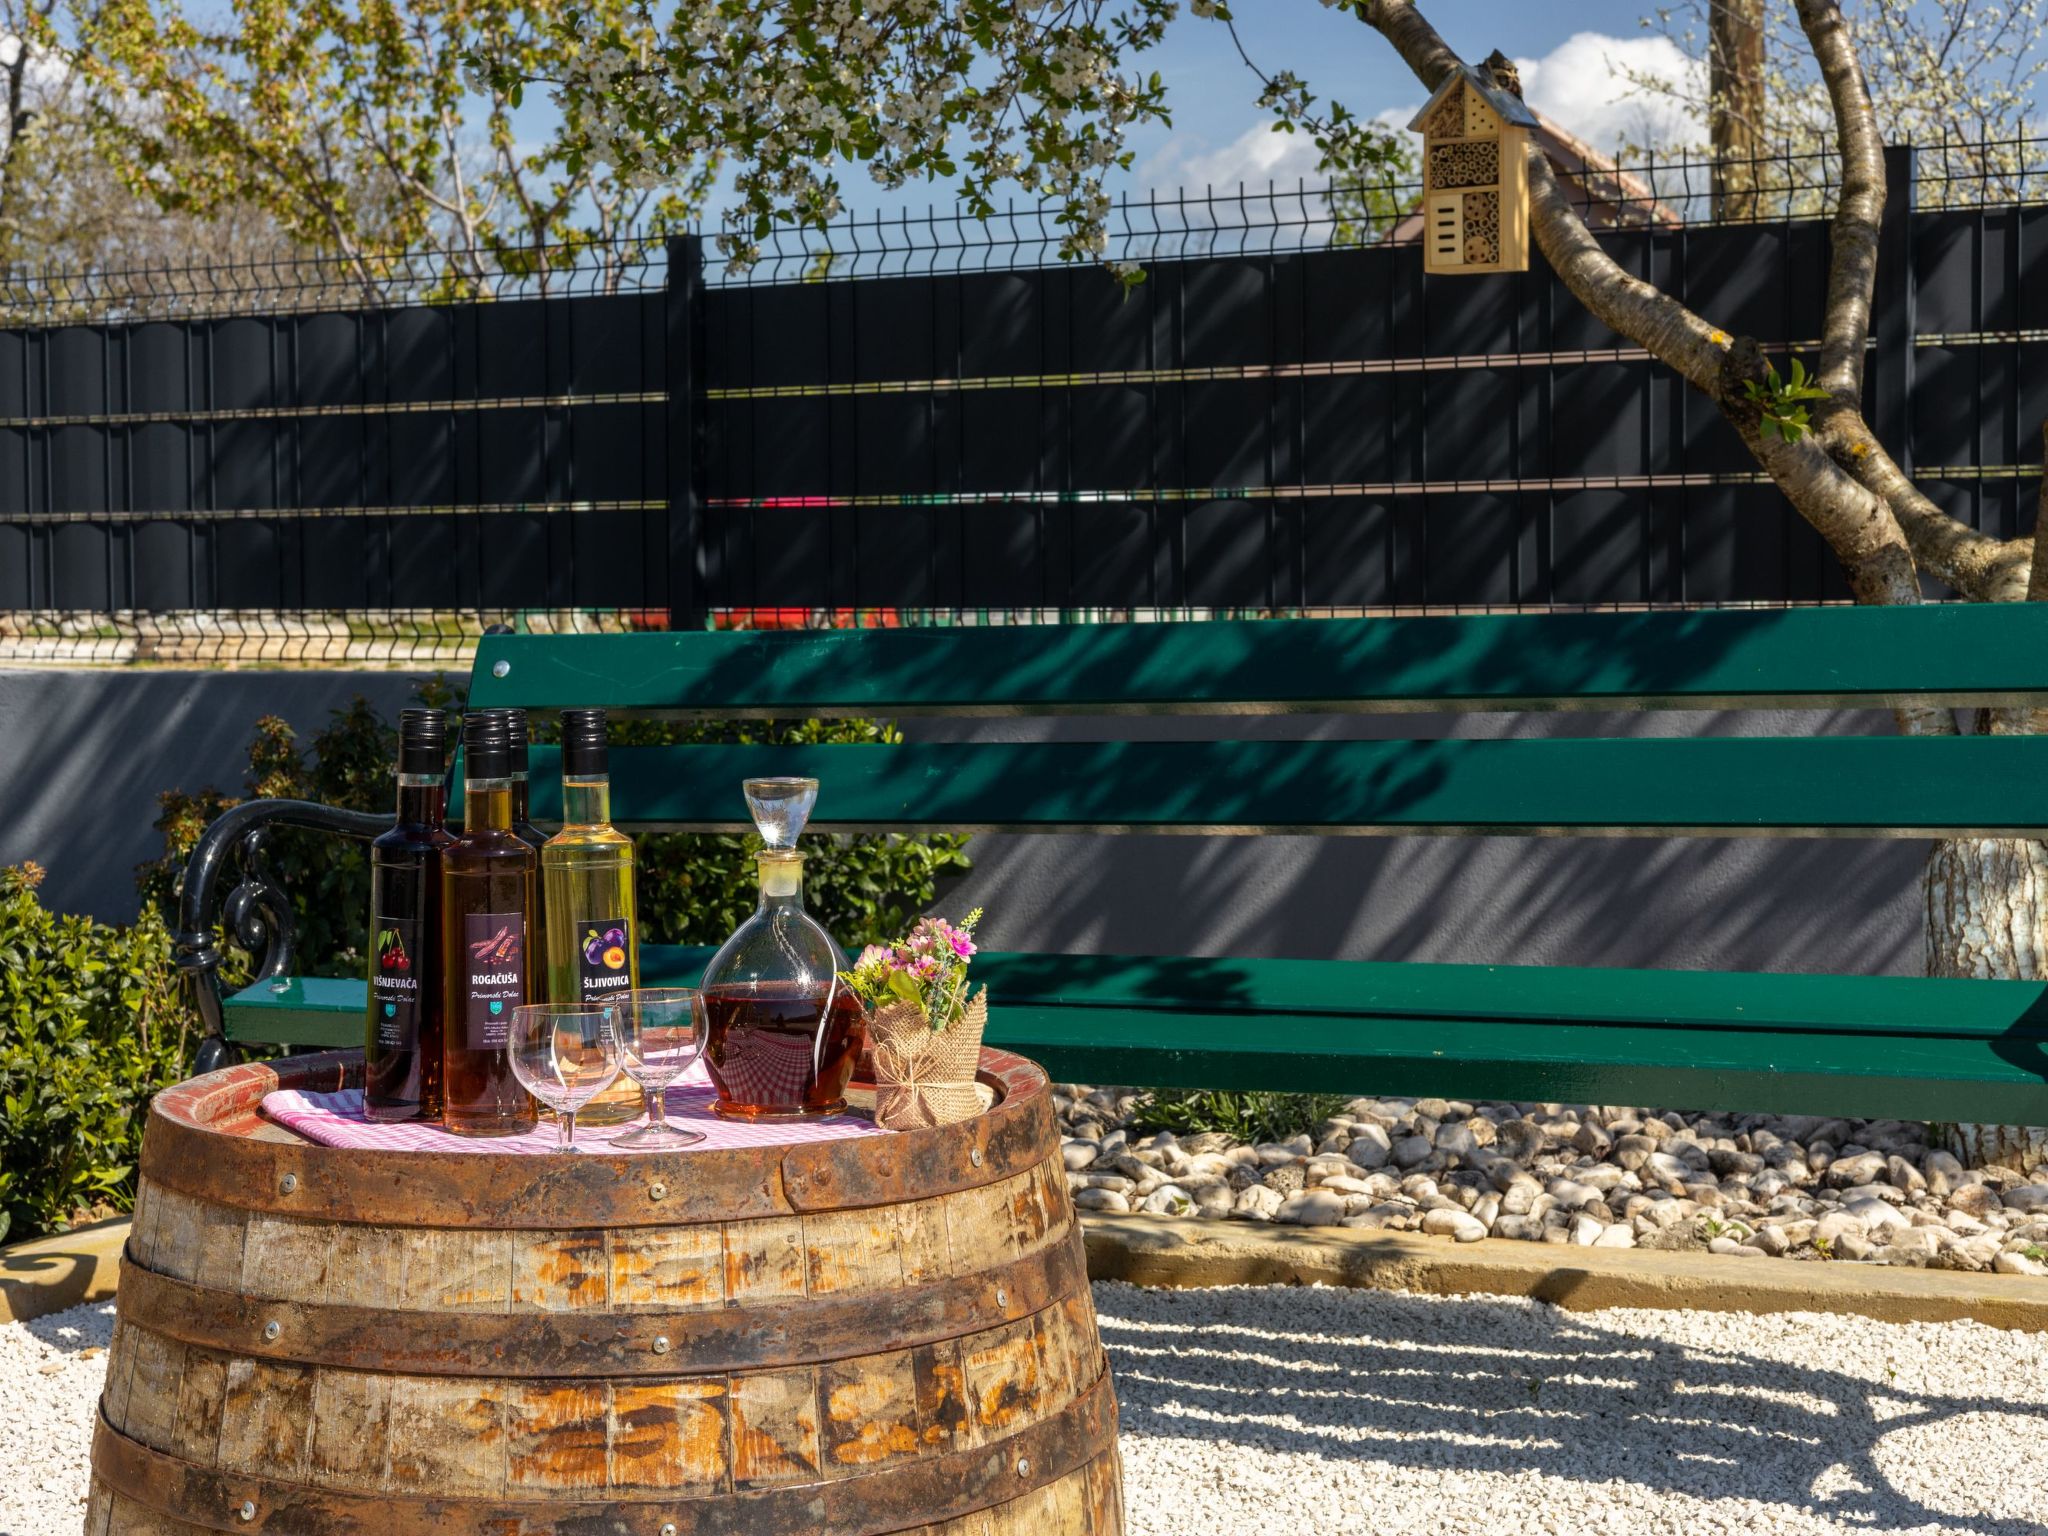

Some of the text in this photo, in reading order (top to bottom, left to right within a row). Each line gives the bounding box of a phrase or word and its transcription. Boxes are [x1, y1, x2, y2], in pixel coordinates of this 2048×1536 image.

[373, 975, 418, 989] VIŠNJEVAČA
[472, 972, 518, 985] ROGAČUŠA
[584, 975, 629, 988] ŠLJIVOVICA
[471, 991, 502, 1000] Primorski
